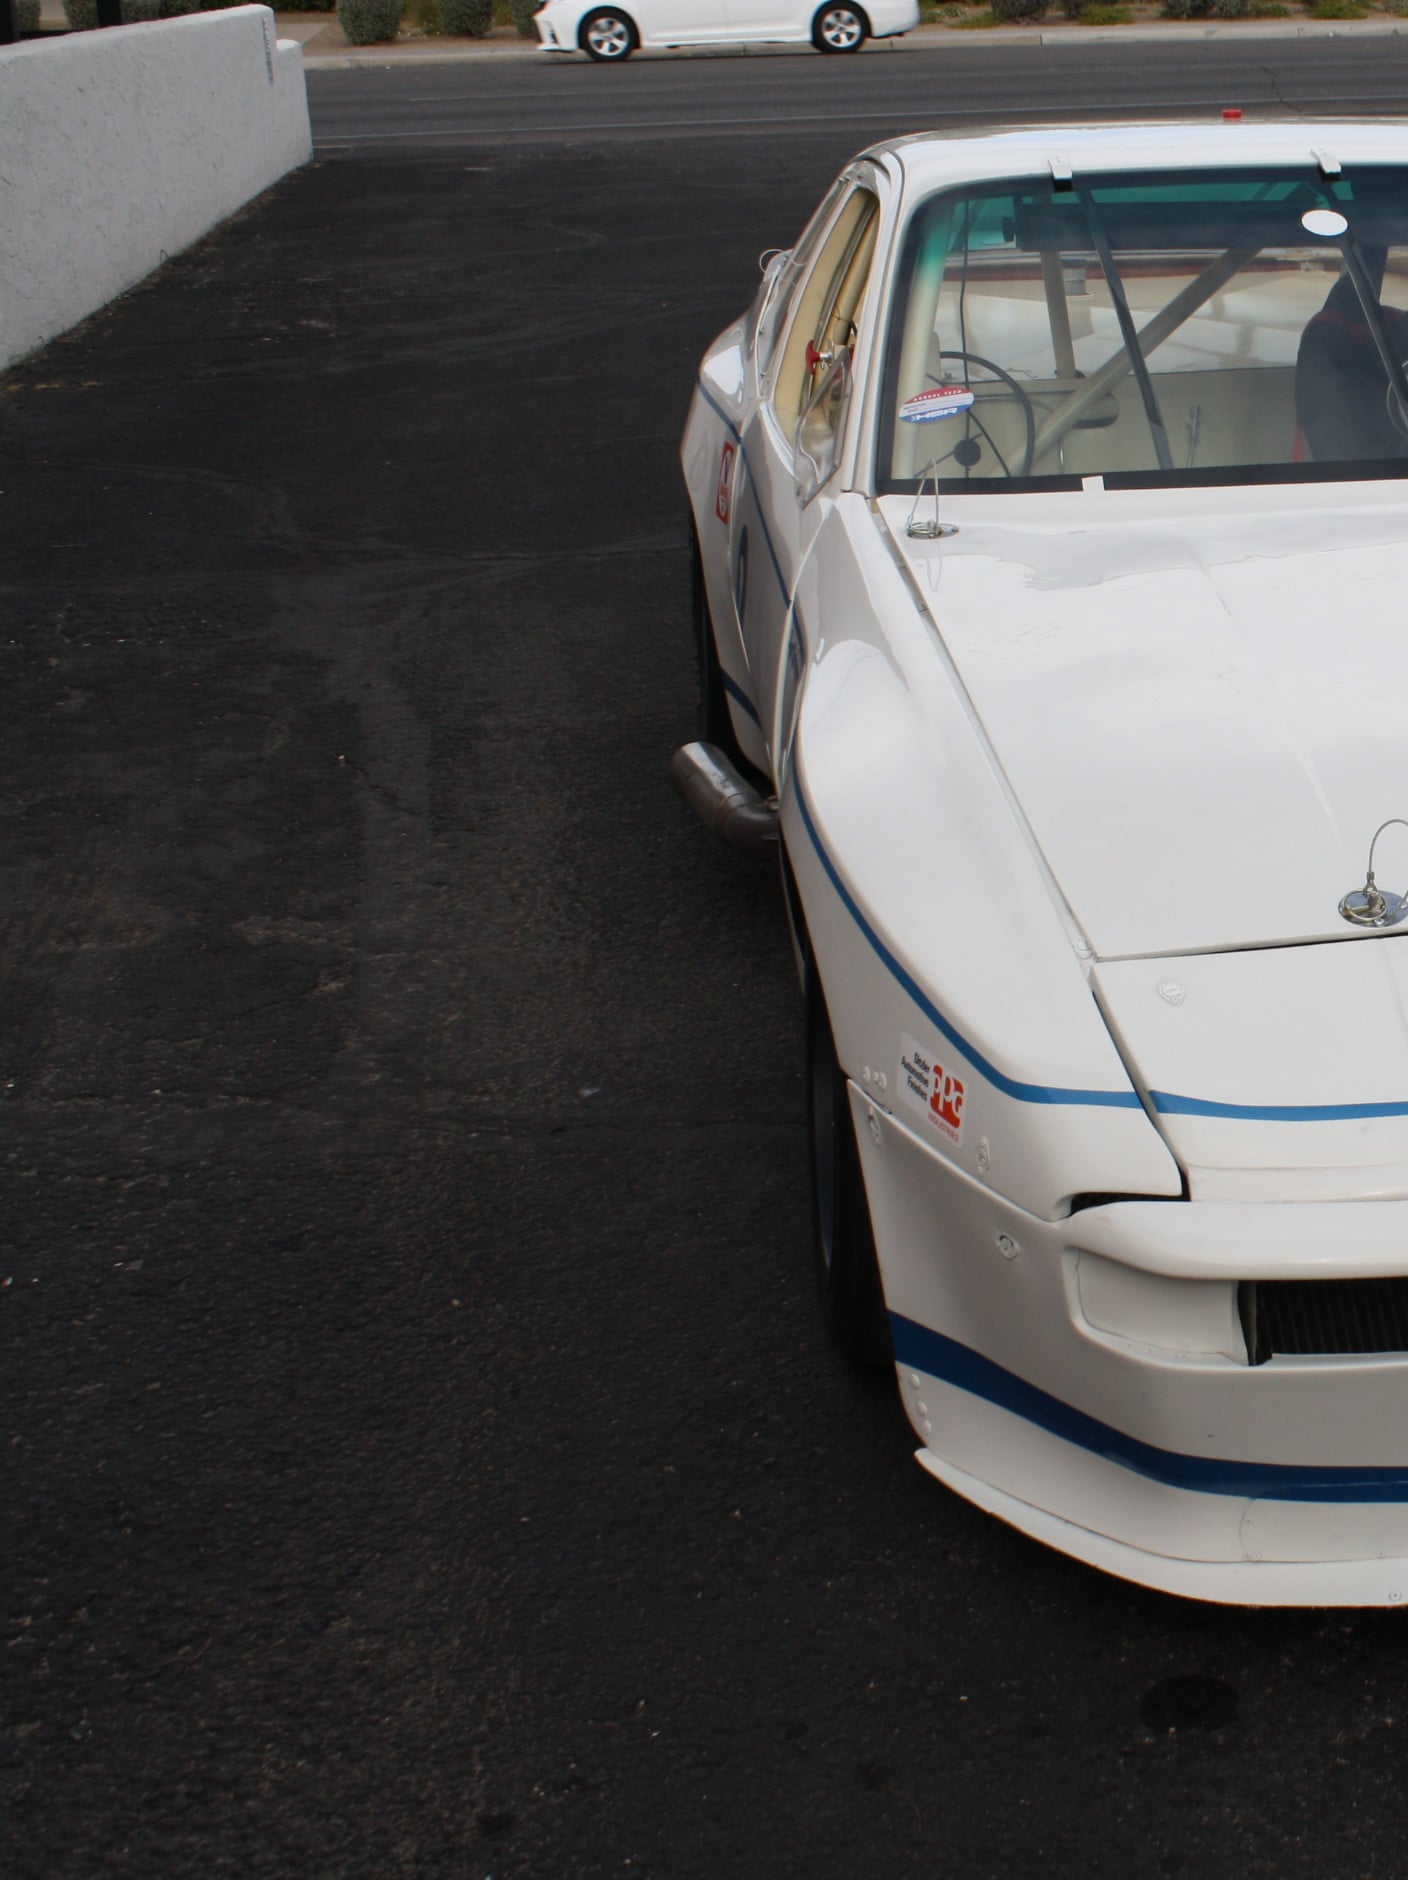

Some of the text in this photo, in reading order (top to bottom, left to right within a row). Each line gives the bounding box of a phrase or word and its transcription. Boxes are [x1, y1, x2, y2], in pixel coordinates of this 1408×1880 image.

[912, 393, 940, 401] ANNUAL
[930, 1066, 964, 1123] PPG
[928, 1112, 960, 1143] INDUSTRIES
